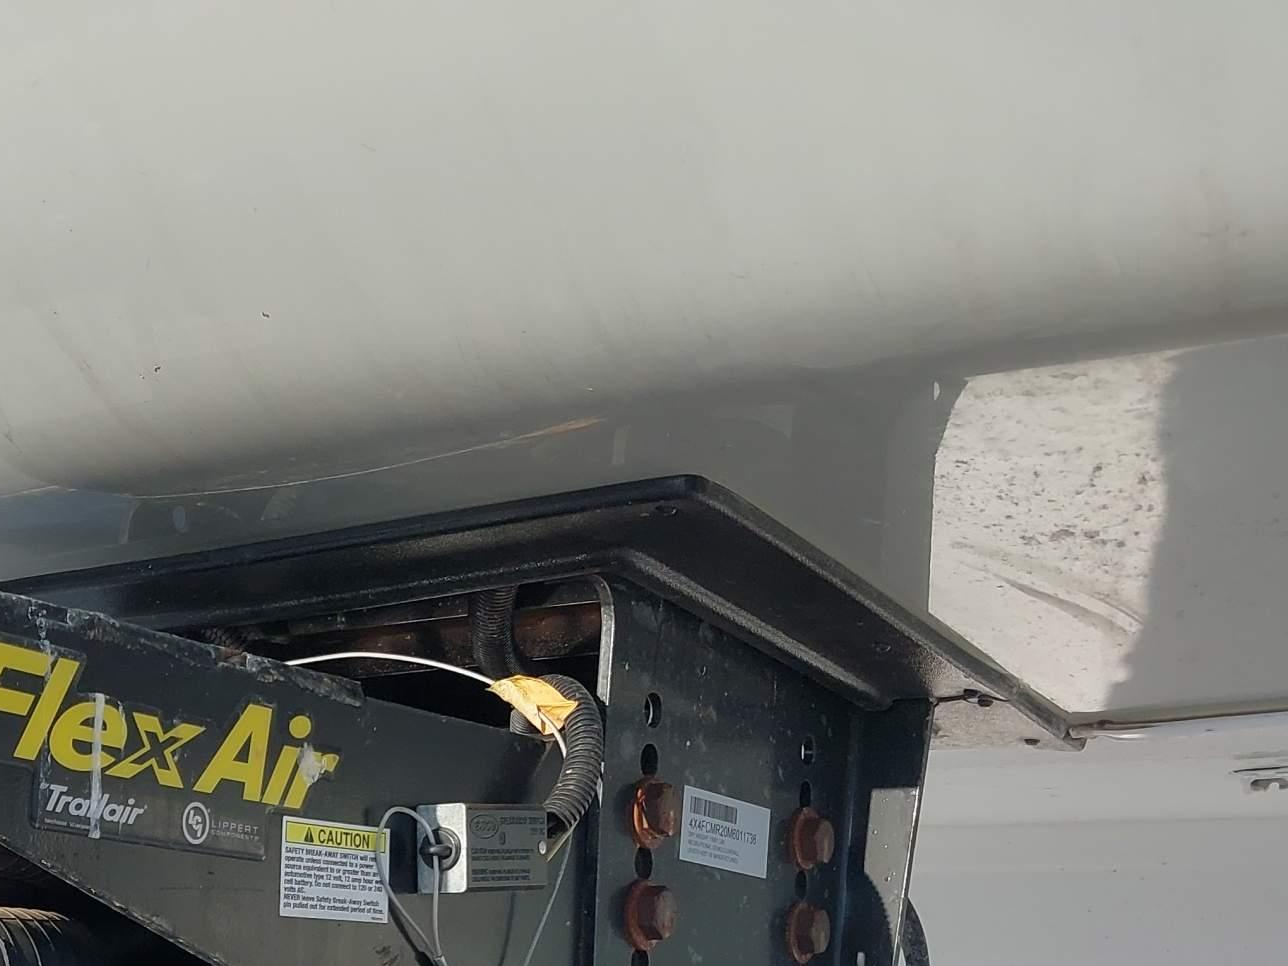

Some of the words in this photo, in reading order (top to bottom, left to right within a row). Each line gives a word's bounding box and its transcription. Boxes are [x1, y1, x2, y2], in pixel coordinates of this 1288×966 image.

[192, 703, 340, 809] Air
[46, 784, 145, 824] Tralair
[212, 820, 259, 833] LIPPERT
[318, 829, 370, 849] CAUTION
